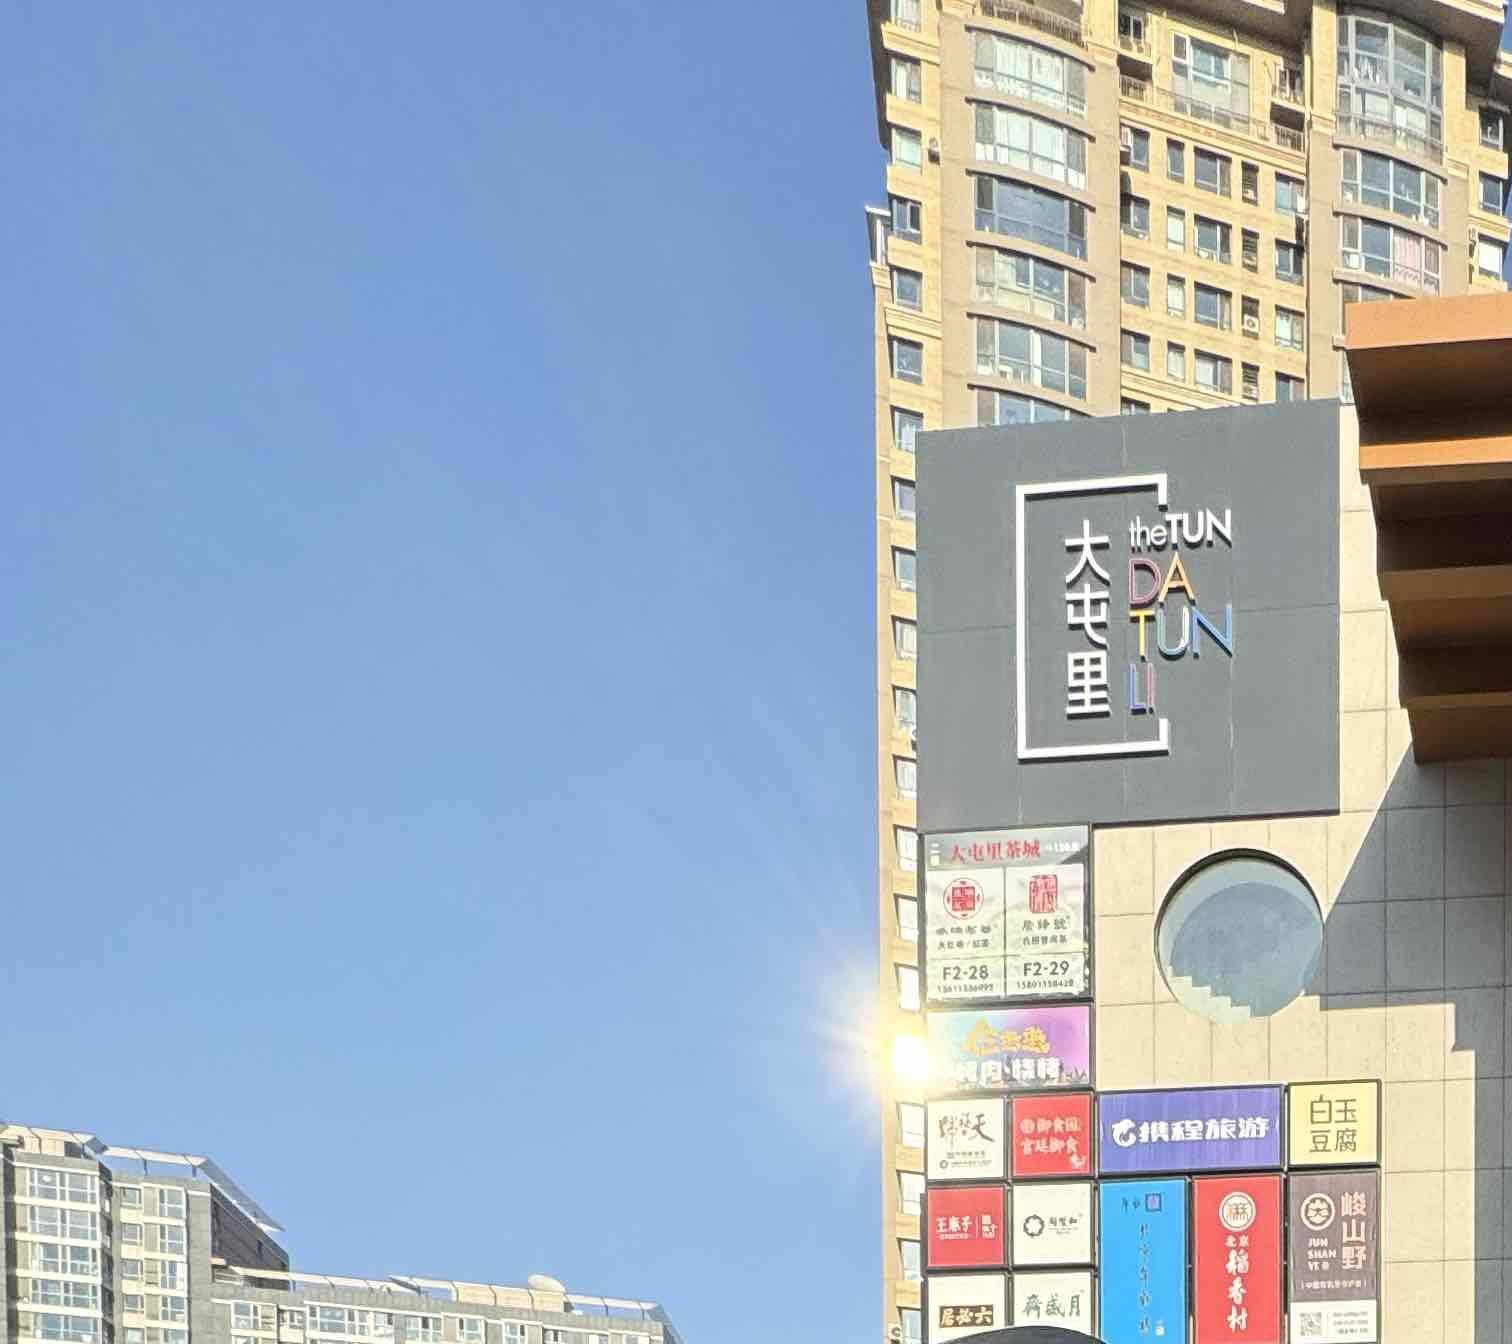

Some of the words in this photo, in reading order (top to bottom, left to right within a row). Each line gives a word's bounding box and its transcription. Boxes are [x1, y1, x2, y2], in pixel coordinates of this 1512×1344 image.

[1128, 552, 1196, 606] DA
[1065, 519, 1111, 715] 大屯里
[1128, 604, 1233, 658] TUN
[942, 965, 990, 981] F2-28
[1022, 960, 1070, 977] F2-29
[1309, 1094, 1358, 1125] 白玉
[1138, 1116, 1270, 1143] 携程旅游
[1309, 1128, 1358, 1153] 豆腐
[1307, 1238, 1329, 1248] JUN
[1341, 1191, 1367, 1270] 峻山野
[1307, 1249, 1337, 1259] SHAN
[1225, 1250, 1250, 1333] 稻香村
